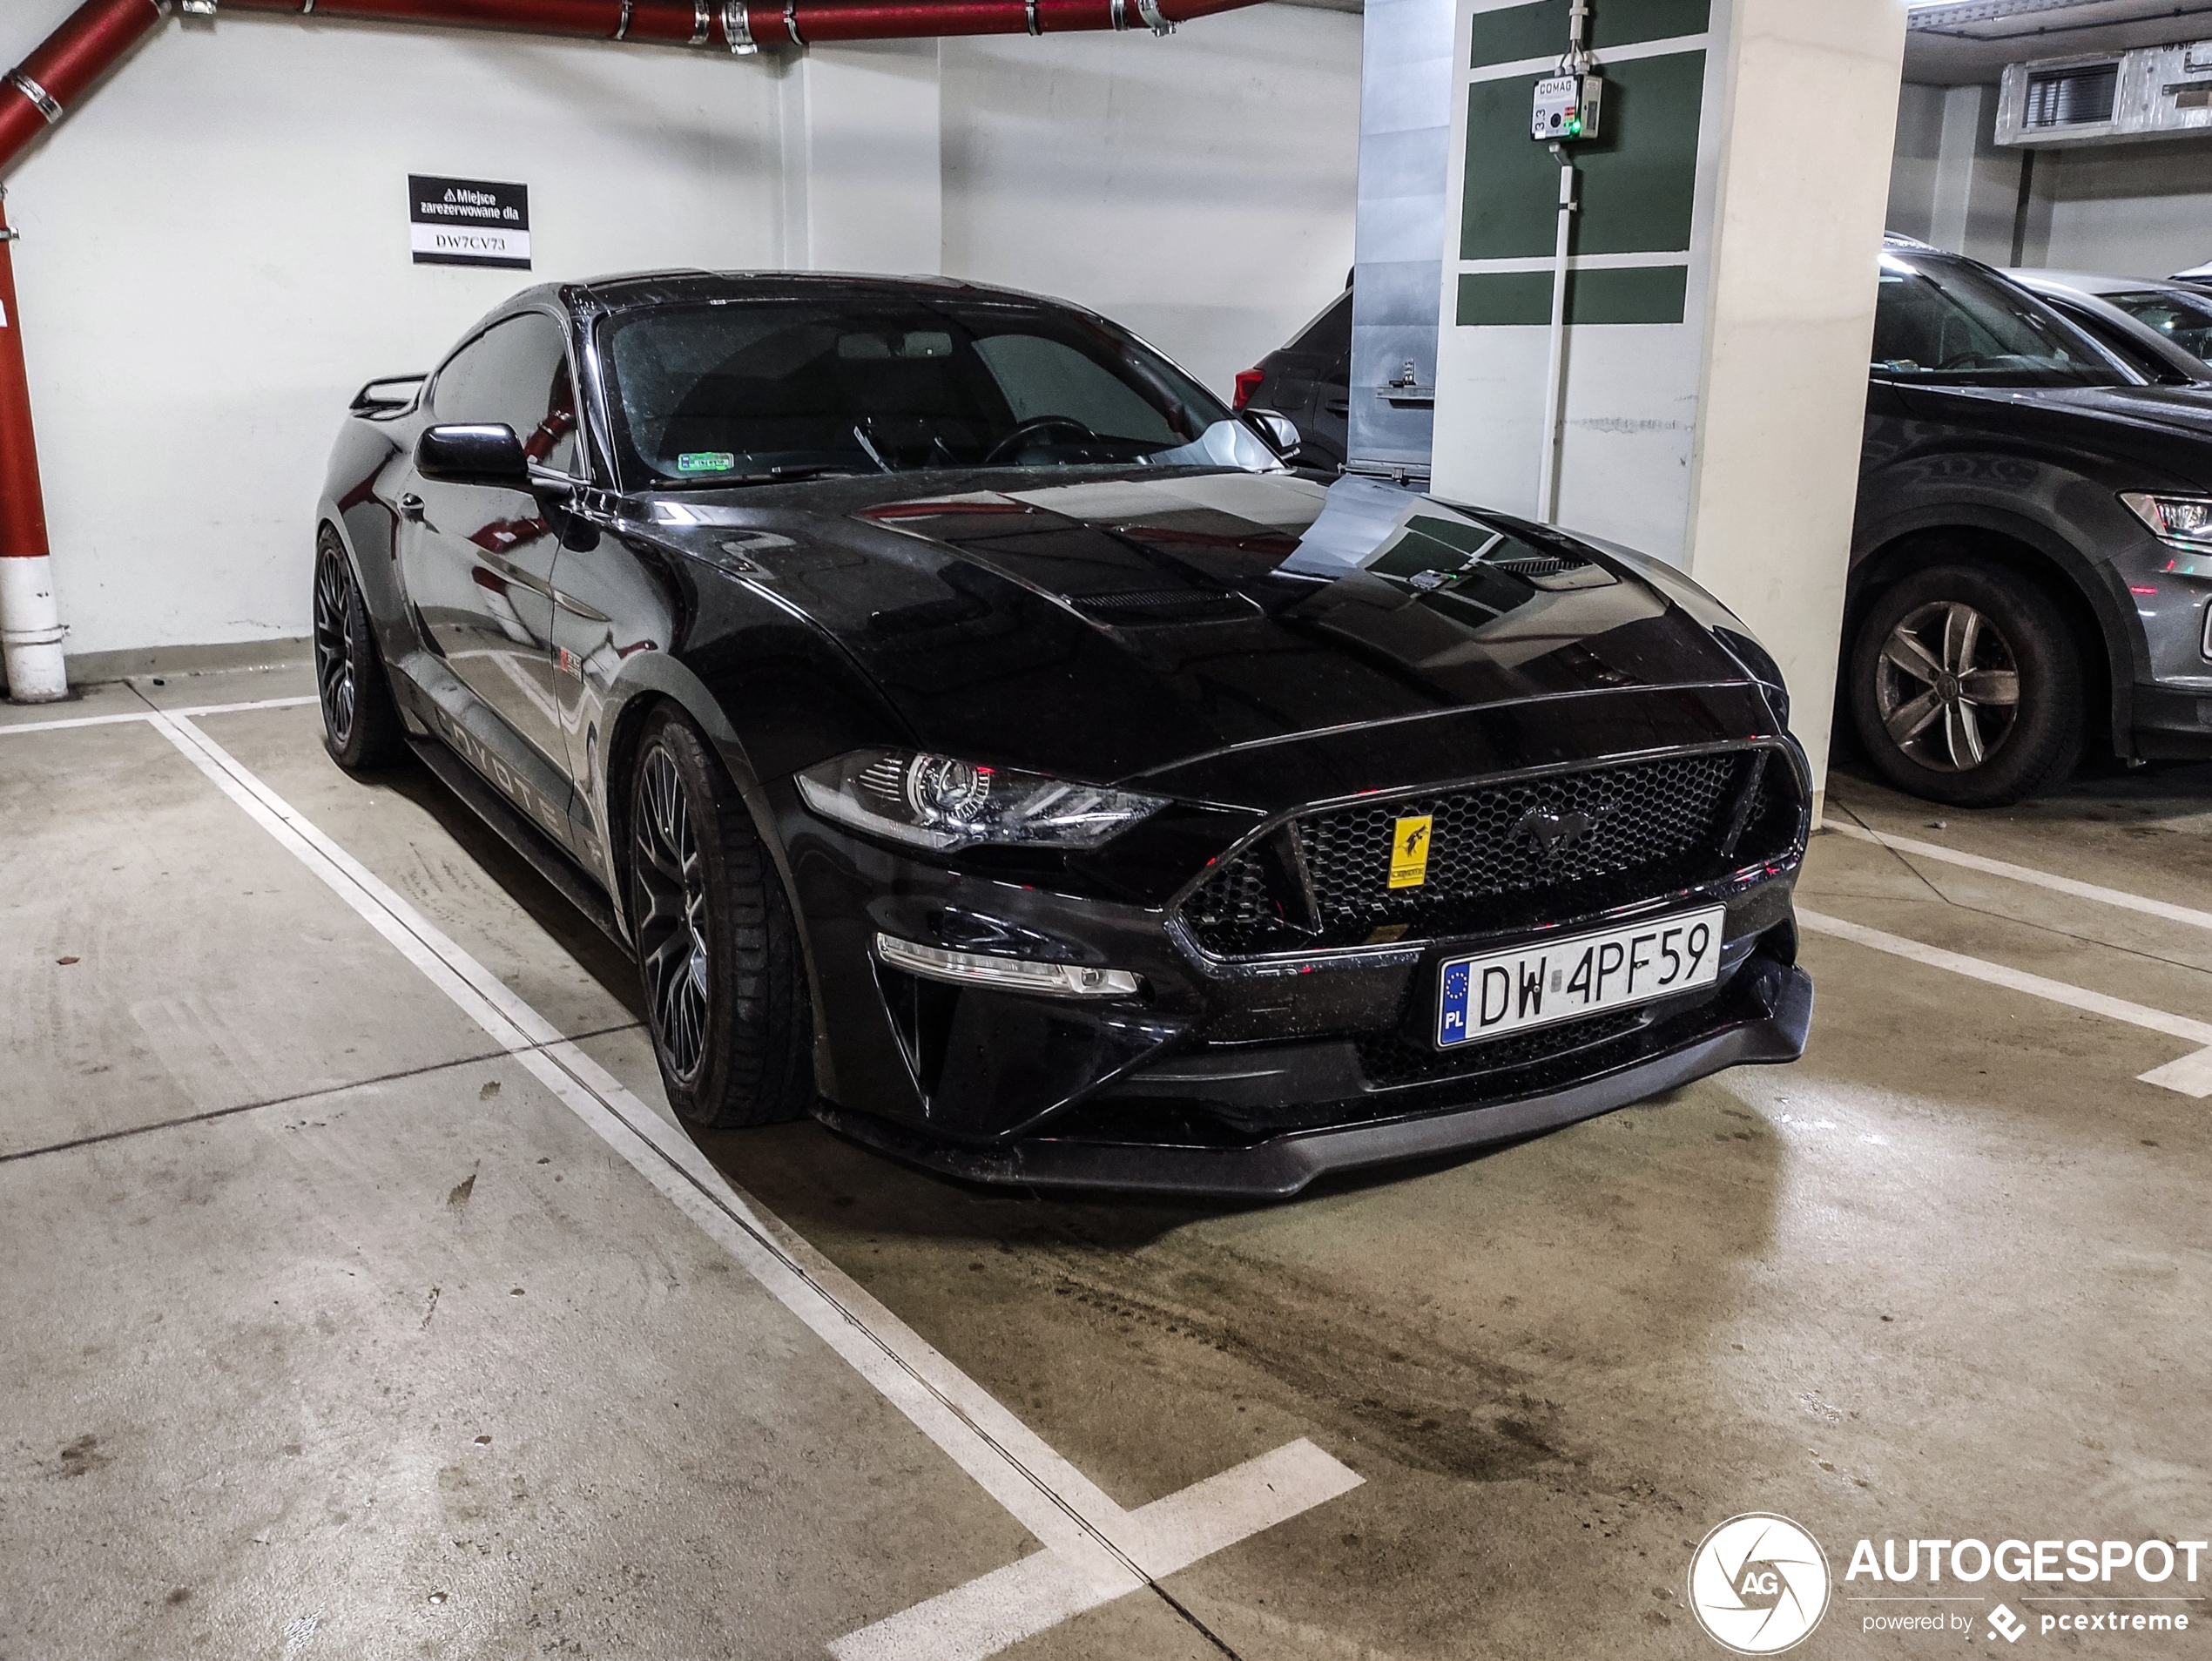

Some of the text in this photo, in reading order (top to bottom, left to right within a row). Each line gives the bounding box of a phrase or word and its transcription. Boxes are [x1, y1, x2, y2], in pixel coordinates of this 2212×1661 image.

[1540, 80, 1571, 95] COMAG
[457, 188, 496, 206] Miejsce
[421, 202, 519, 220] zarezerwowane dla
[435, 234, 506, 251] DW7CV73
[1480, 921, 1710, 1028] DW 4PF59
[1445, 1010, 1464, 1030] PL
